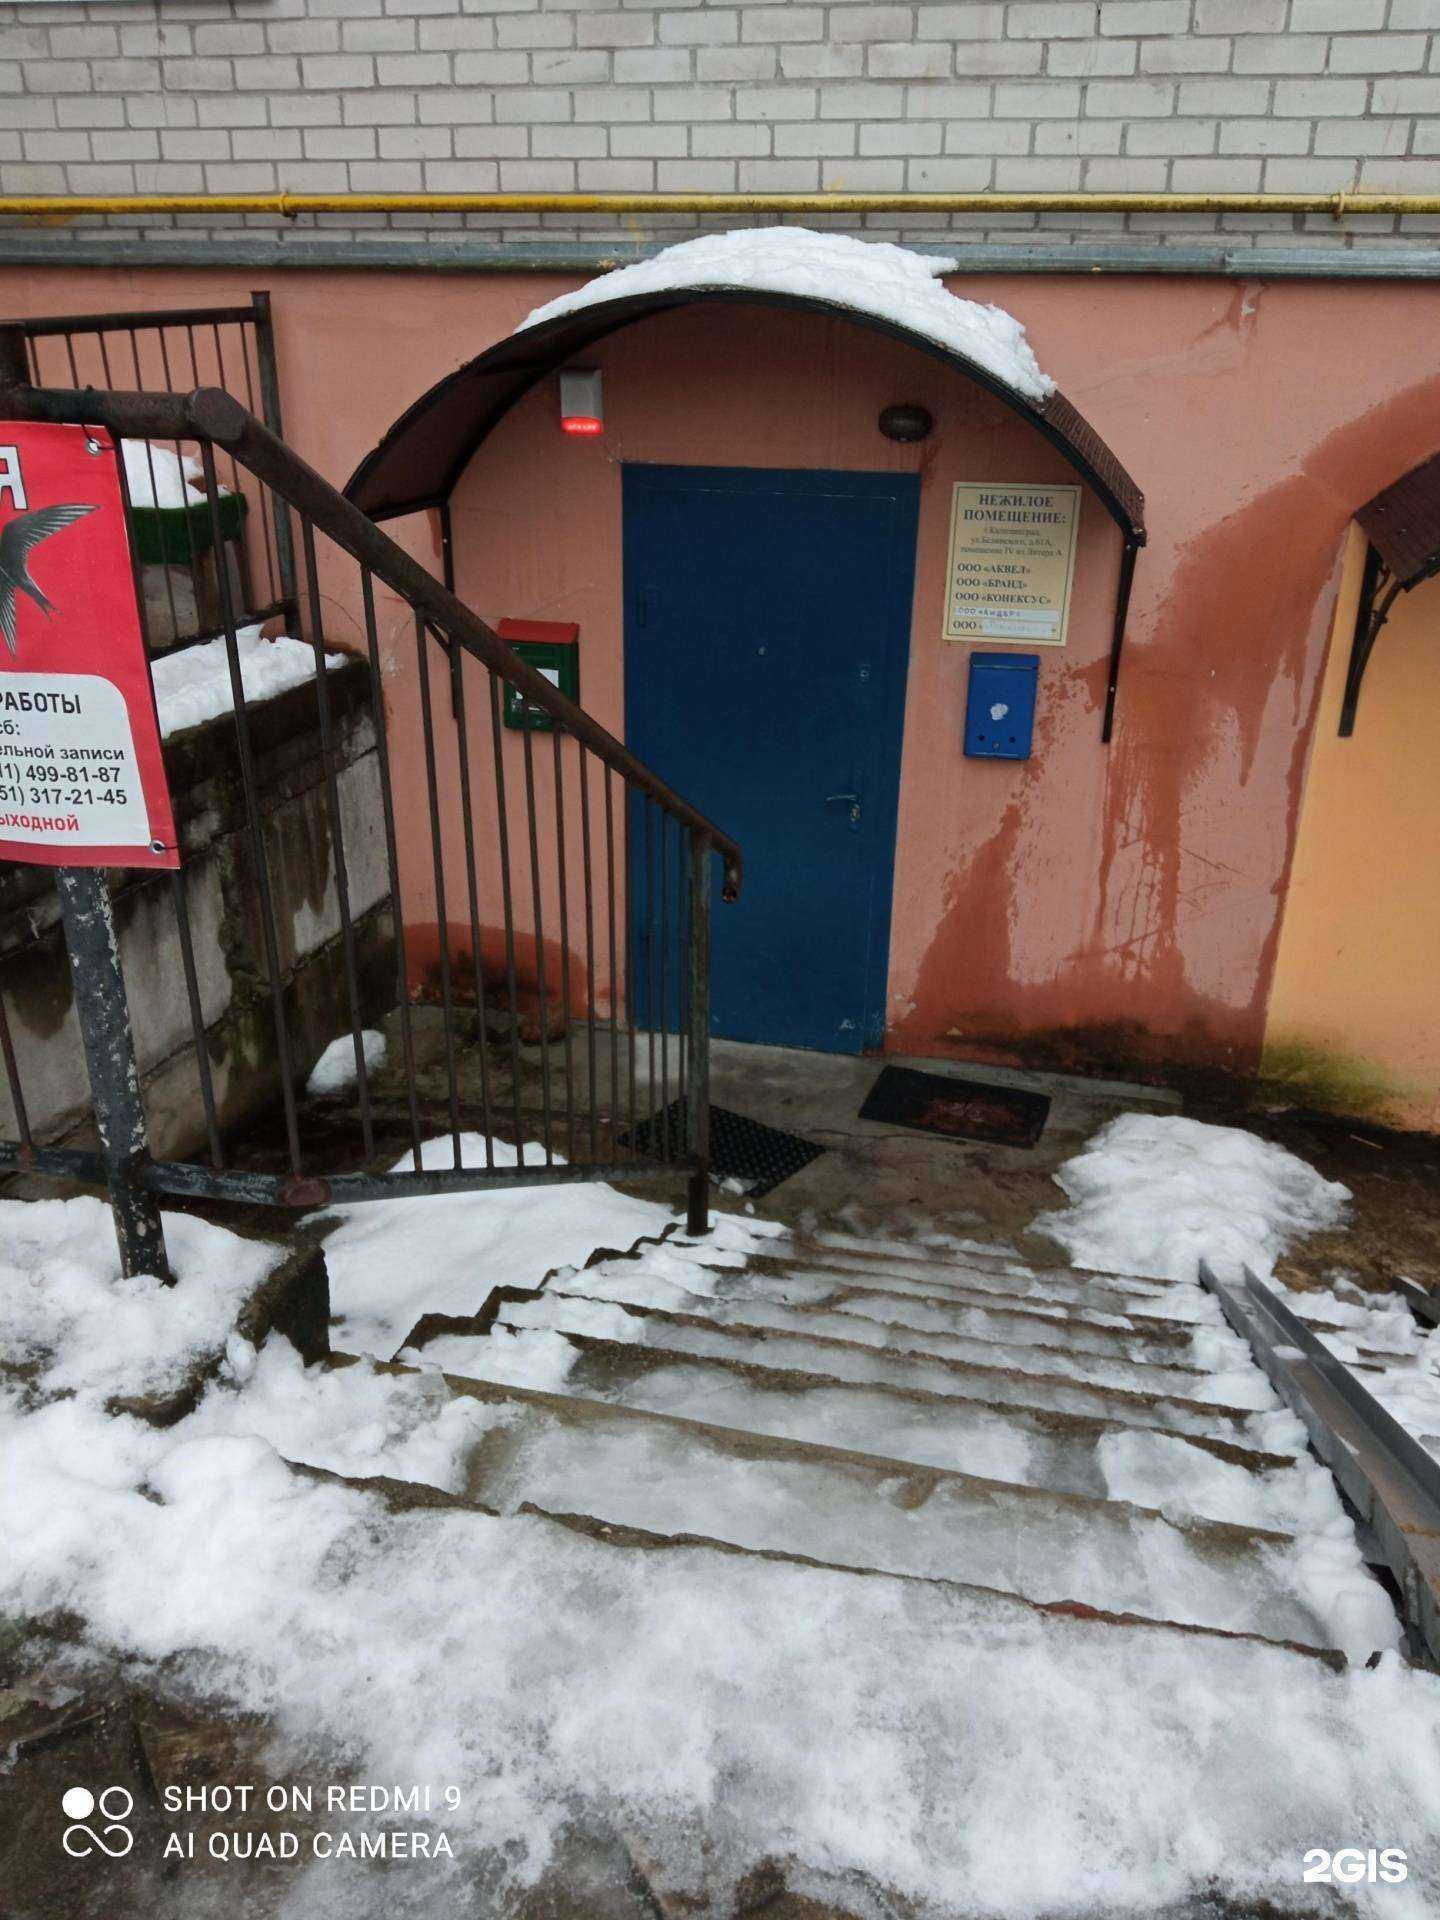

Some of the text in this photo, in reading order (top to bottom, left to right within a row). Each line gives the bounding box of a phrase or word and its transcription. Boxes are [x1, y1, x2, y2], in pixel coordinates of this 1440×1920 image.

[979, 494, 1055, 508] НЕЖИЛОЕ
[964, 509, 1066, 524] ПОМЕЩЕНИЕ:
[957, 563, 1031, 575] ООО «АКВЕЛ»
[956, 578, 1028, 590] ООО «БРАНД»
[955, 592, 1052, 605] ООО «КОНЕКСУС»
[953, 620, 977, 630] ООО
[60, 748, 125, 761] записи
[26, 765, 121, 783] 499-81-87
[30, 787, 127, 805] 317-21-45
